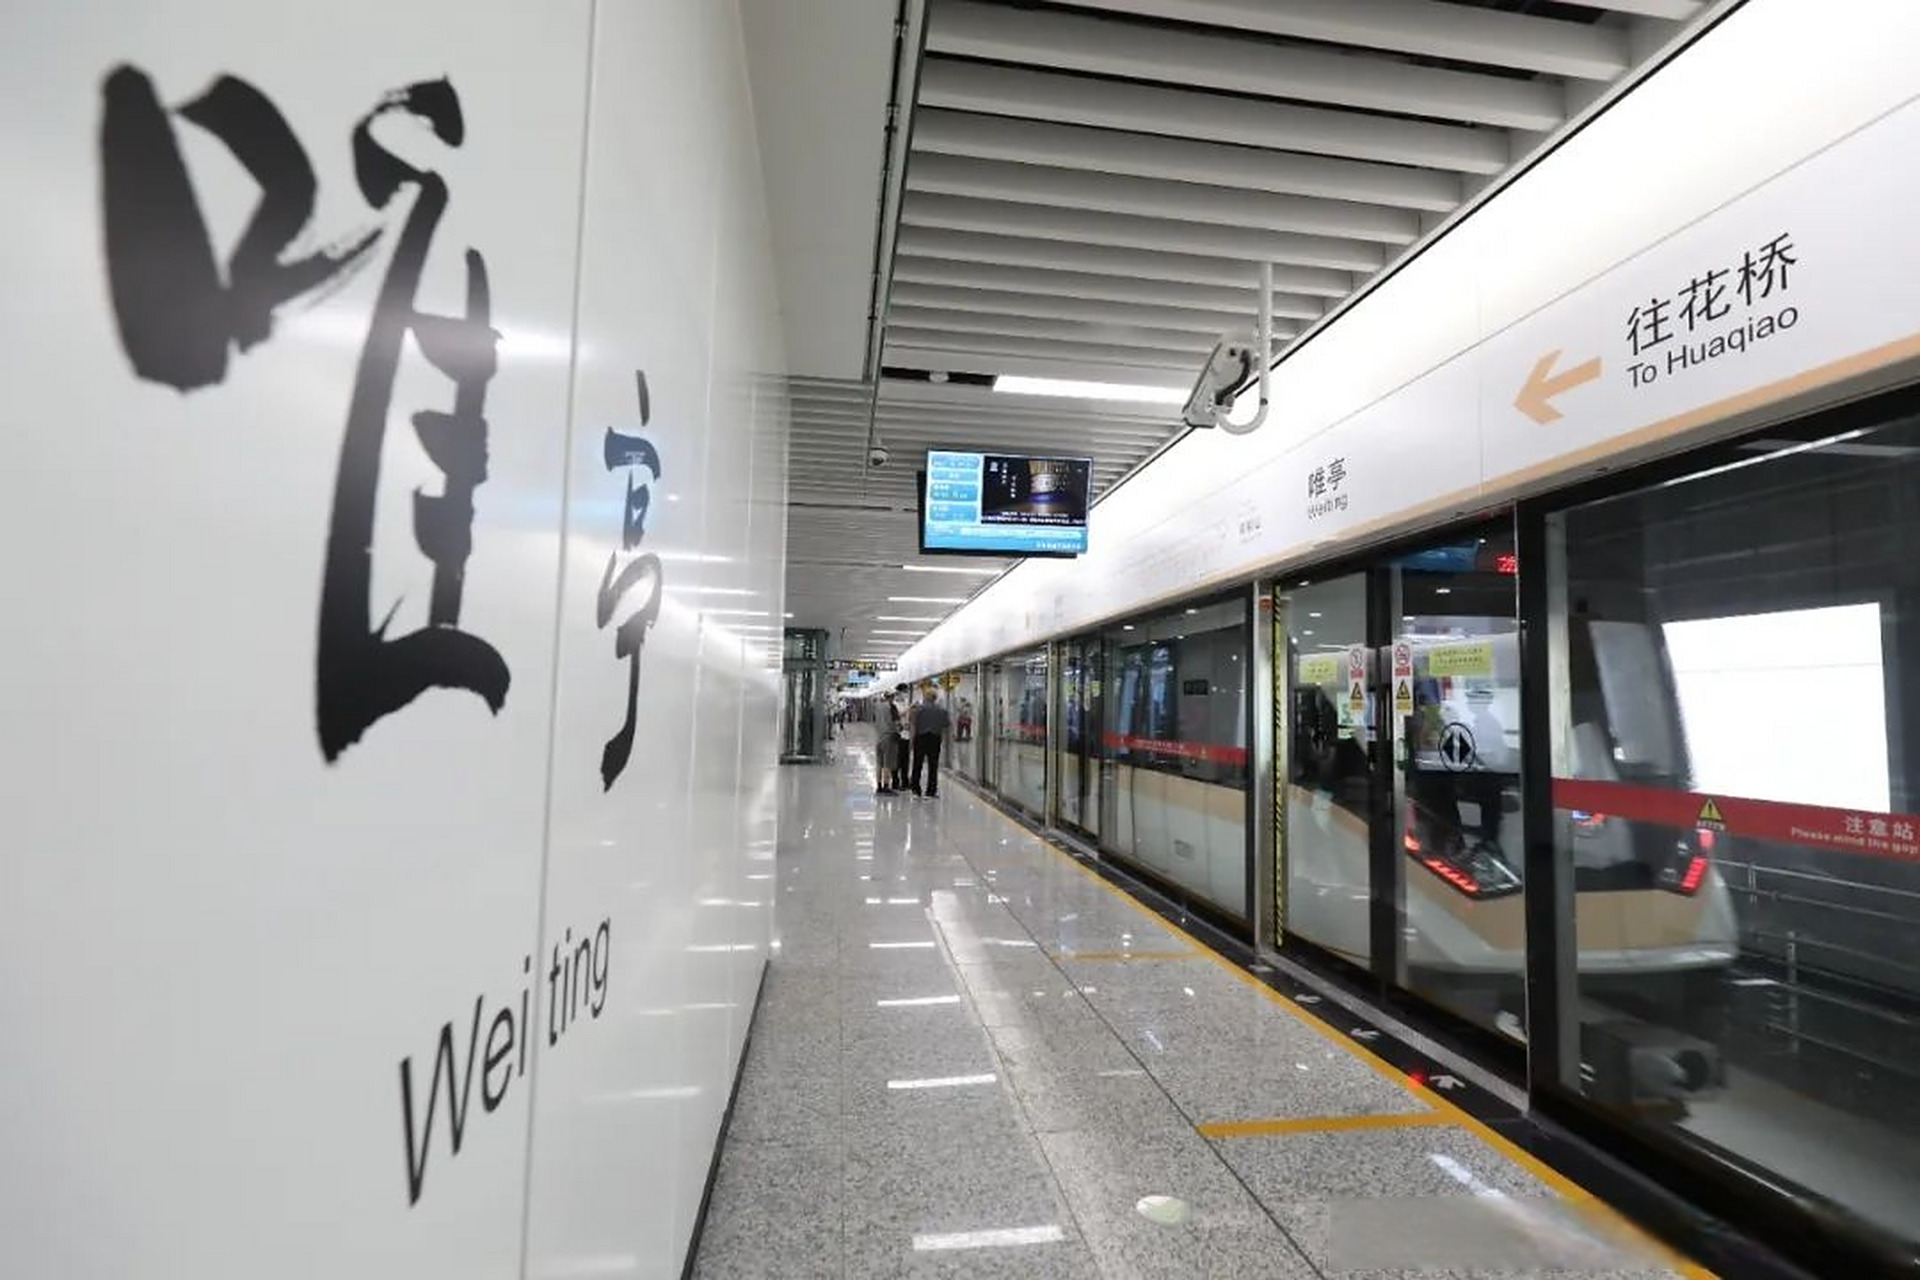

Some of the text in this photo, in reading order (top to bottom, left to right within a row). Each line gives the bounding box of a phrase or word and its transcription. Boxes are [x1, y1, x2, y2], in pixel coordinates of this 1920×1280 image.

[1626, 232, 1797, 356] 往花桥
[1627, 306, 1799, 388] To Huaqiao
[1308, 457, 1347, 498] 唯亭
[1843, 815, 1914, 841] 注意站
